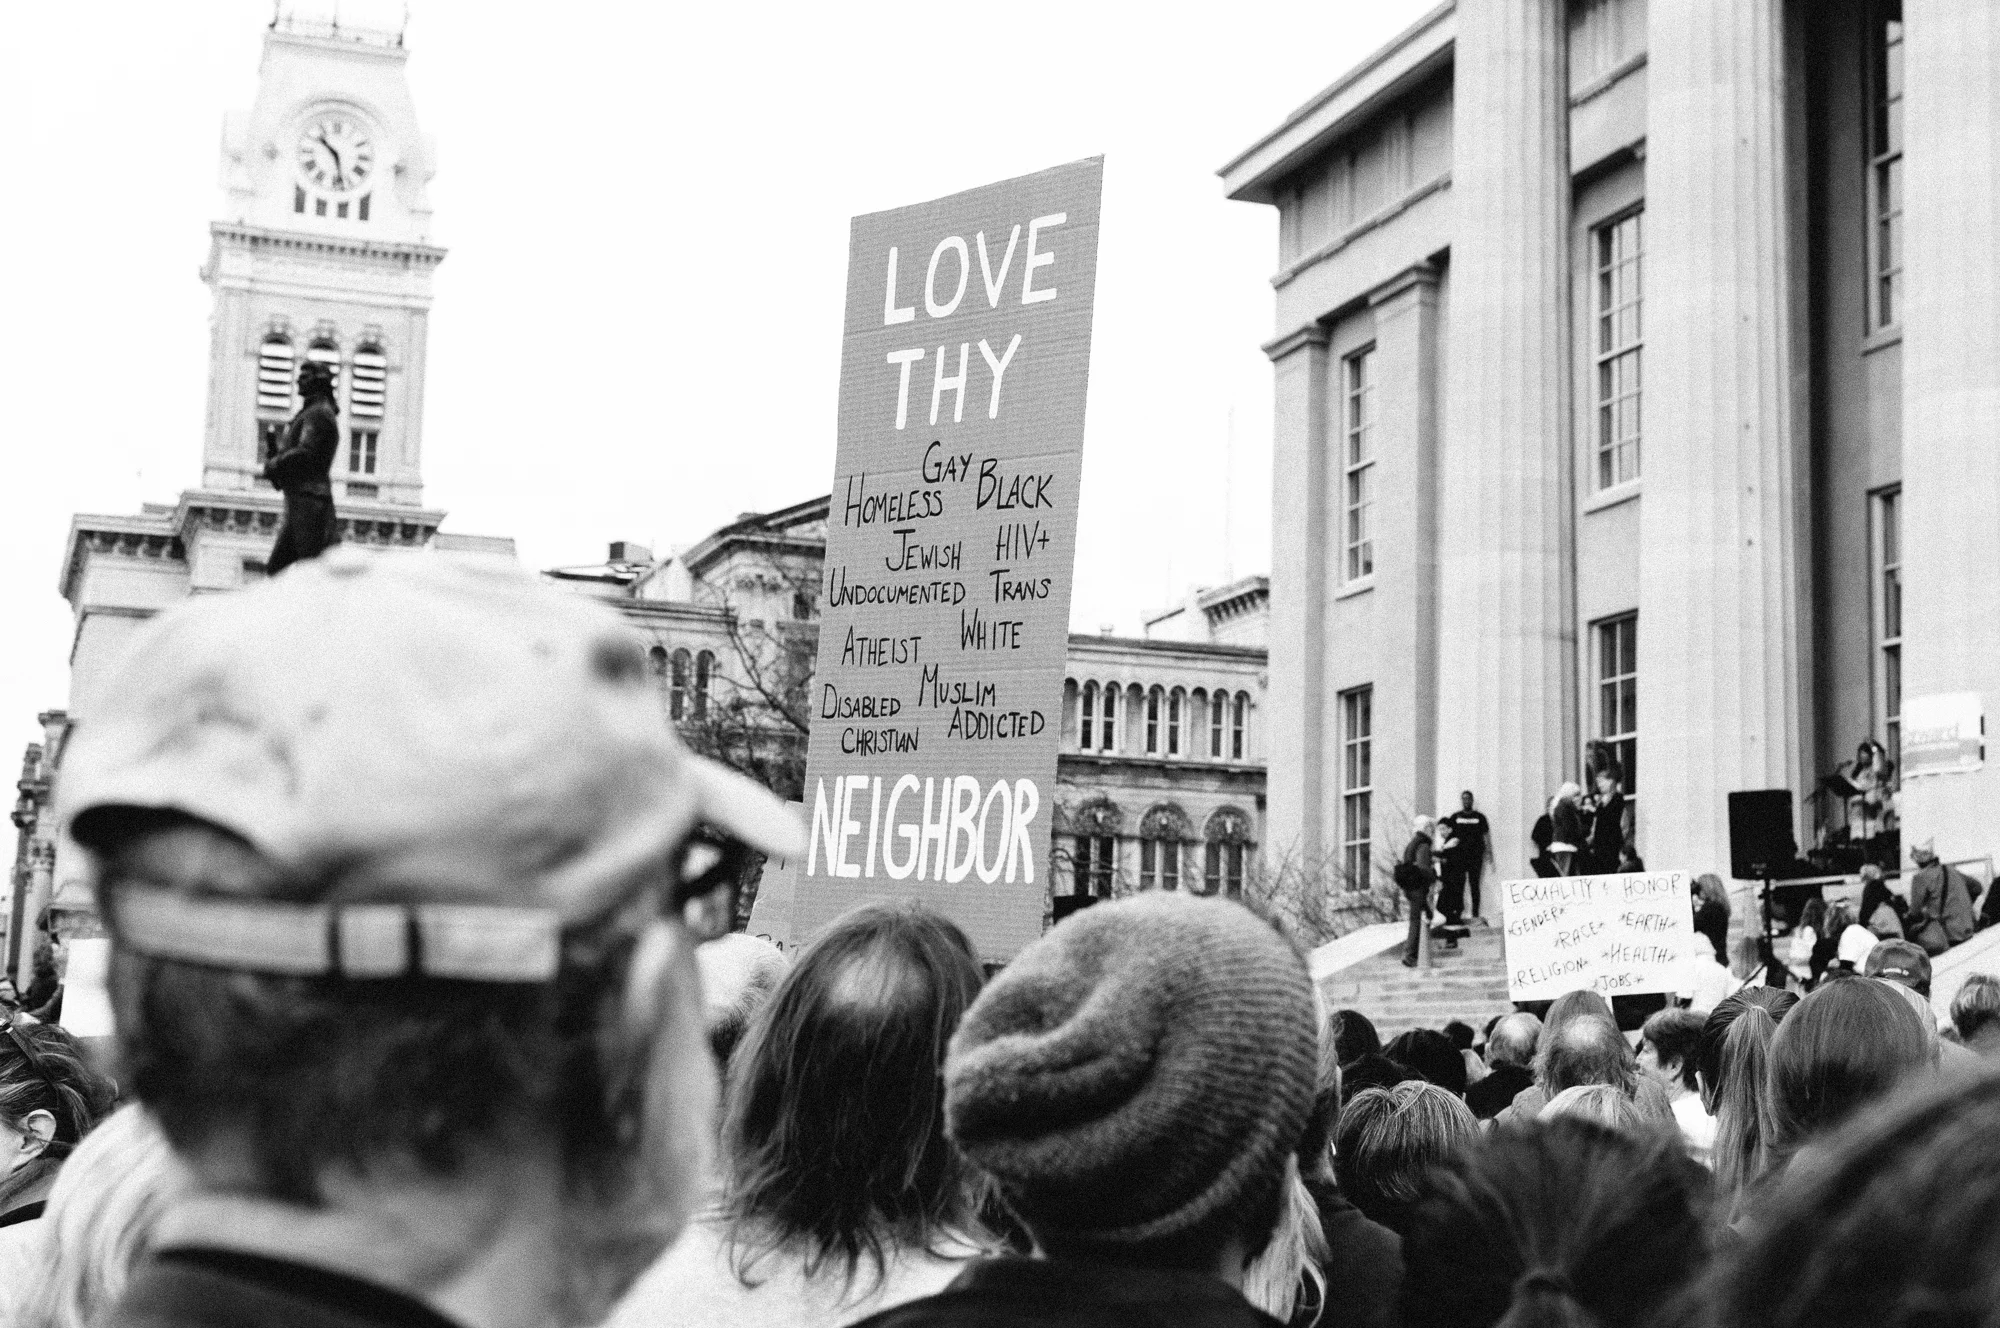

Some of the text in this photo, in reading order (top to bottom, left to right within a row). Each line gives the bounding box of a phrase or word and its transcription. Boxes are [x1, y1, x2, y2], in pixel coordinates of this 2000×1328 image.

[884, 211, 1067, 326] LOVE
[886, 333, 1022, 430] THY
[922, 440, 973, 484] GAY
[844, 471, 944, 528] HOMELESS
[976, 458, 1053, 510] BLACK
[885, 528, 961, 571] JEWISH
[996, 520, 1050, 561] HIV+
[830, 565, 966, 608] UNDOCUMENTED
[989, 569, 1052, 604] TRANS
[841, 625, 921, 667] ATHEIST
[961, 607, 1024, 650] WHITE
[821, 683, 901, 719] DISABLED
[918, 663, 996, 708] MUSLIM
[841, 727, 919, 756] CHRISTIAN
[947, 706, 1045, 740] ADDICTED
[807, 773, 1039, 884] NEIGHBOR
[1509, 878, 1593, 904] EQUALITY
[1517, 957, 1584, 989] RELIGION
